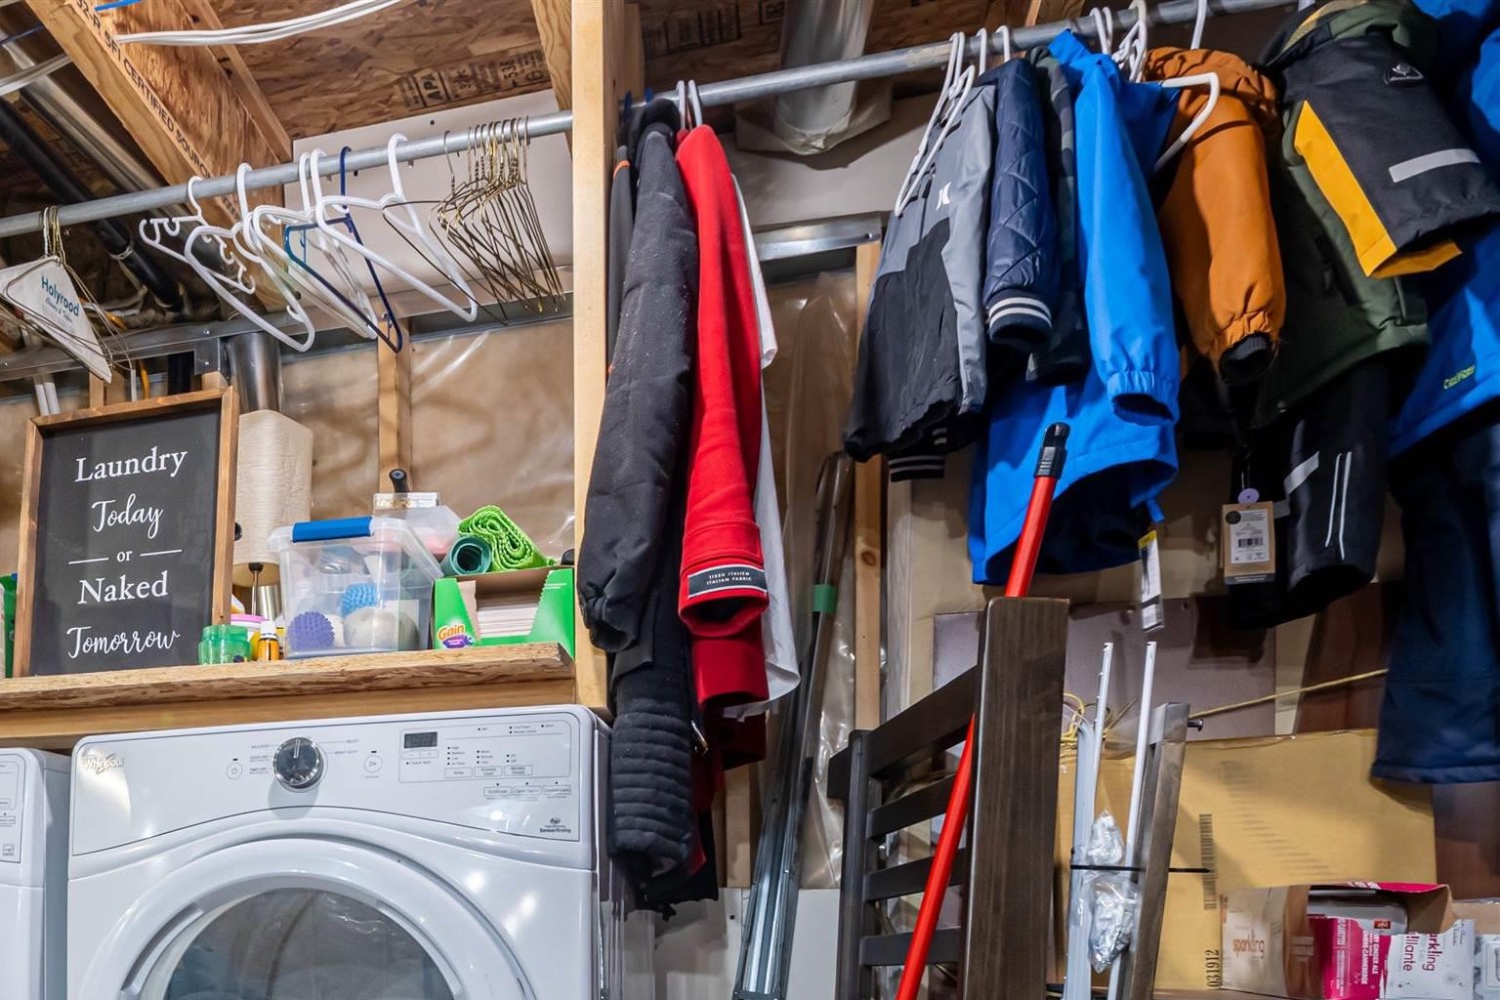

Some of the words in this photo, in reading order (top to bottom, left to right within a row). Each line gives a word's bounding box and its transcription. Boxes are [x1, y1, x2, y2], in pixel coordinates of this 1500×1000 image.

[124, 61, 174, 133] CERTIFIED
[422, 72, 446, 102] APA
[41, 276, 80, 316] Holyrood
[74, 446, 188, 482] Laundry
[91, 493, 163, 539] Today
[116, 550, 132, 562] or
[77, 570, 169, 605] Naked
[706, 577, 730, 585] ITALIAN
[66, 626, 181, 659] Tomorrow
[438, 624, 465, 640] Gain
[84, 754, 124, 774] Whirlpool
[1233, 928, 1265, 959] sparkling
[1371, 943, 1380, 965] GINGER
[1205, 949, 1220, 987] 031912
